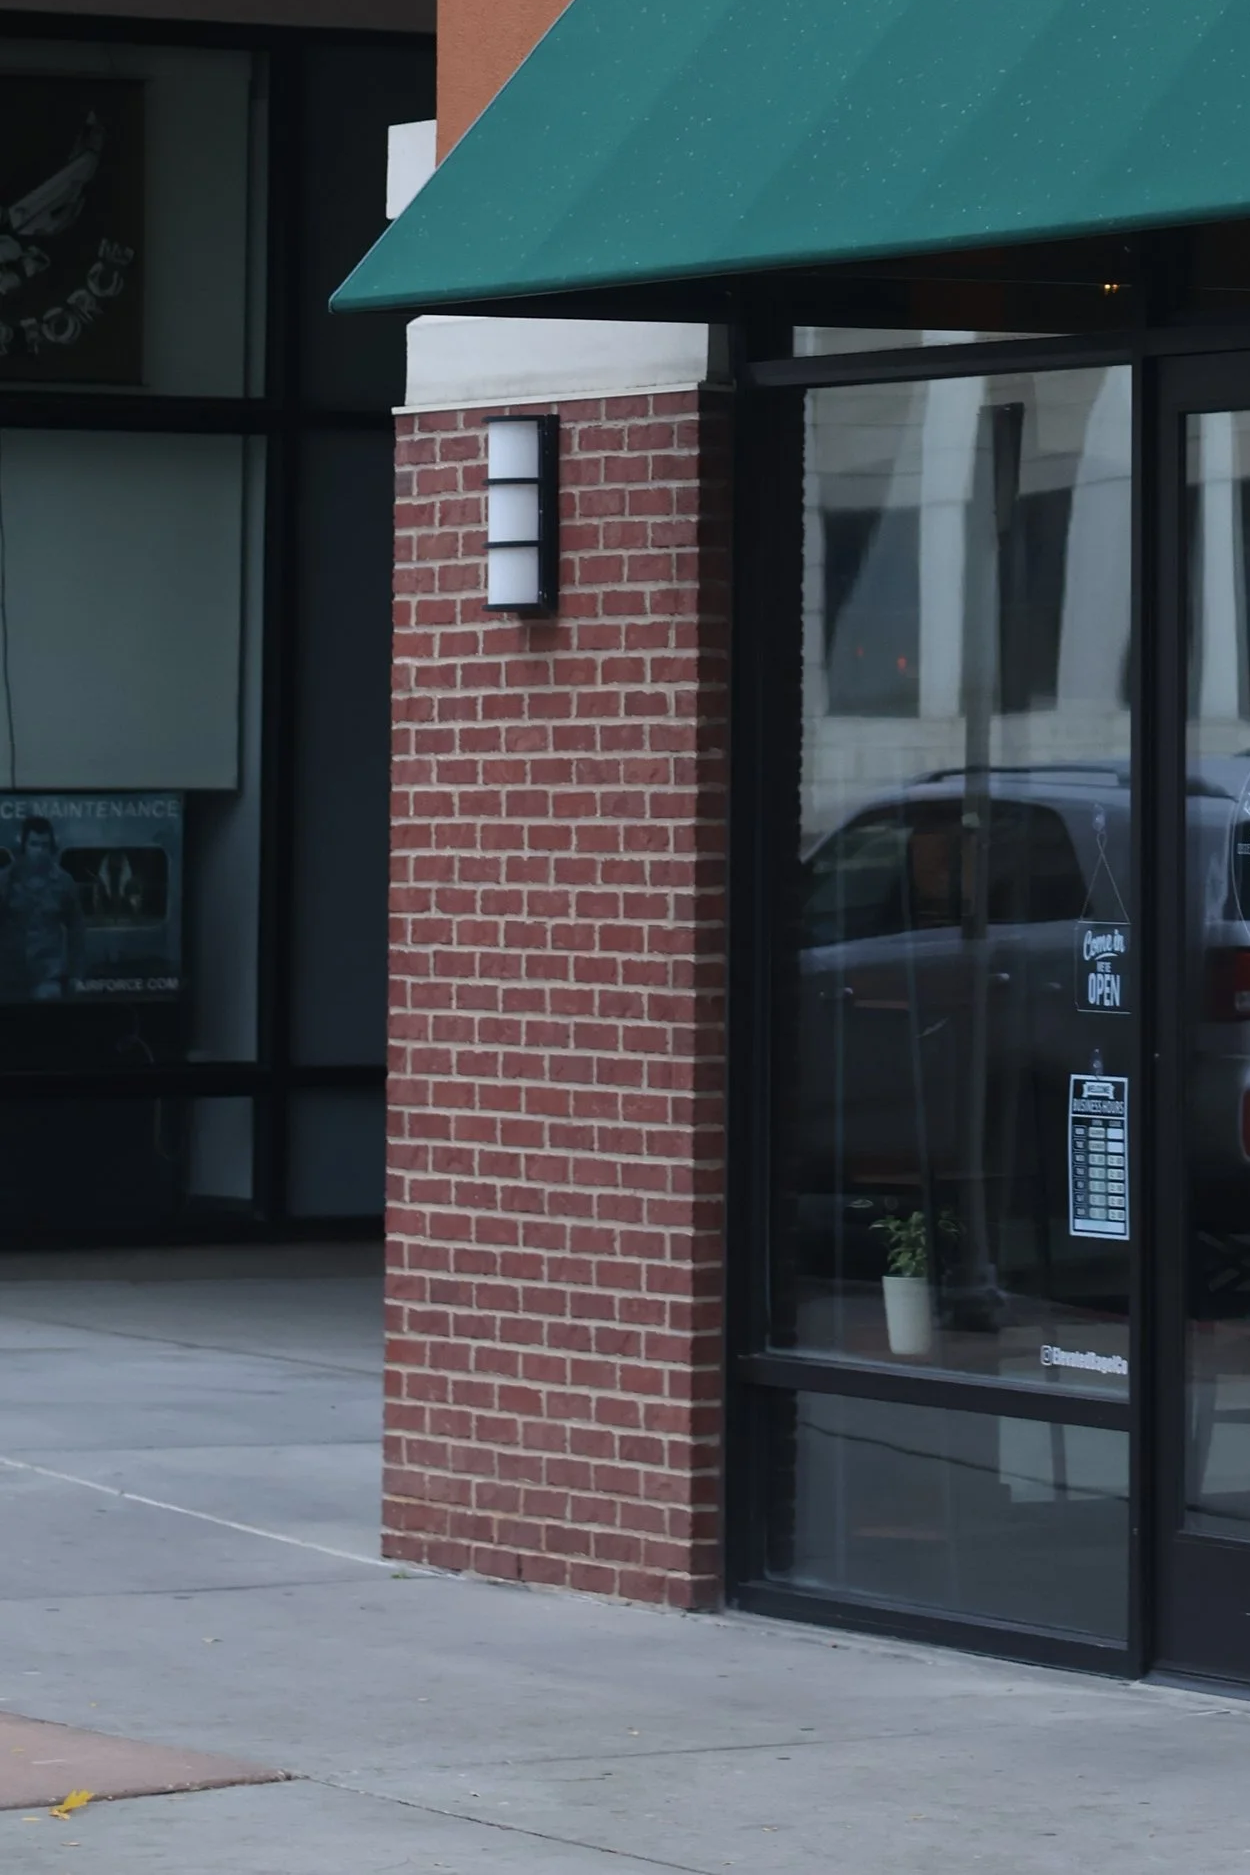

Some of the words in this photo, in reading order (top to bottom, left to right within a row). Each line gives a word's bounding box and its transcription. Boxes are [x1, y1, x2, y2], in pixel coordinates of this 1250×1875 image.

[32, 800, 181, 818] MAINTENANCE
[1083, 929, 1112, 961] Come
[1088, 973, 1121, 1007] OPEN
[1073, 1098, 1106, 1113] BUSINESS
[1107, 1100, 1124, 1115] HOURS
